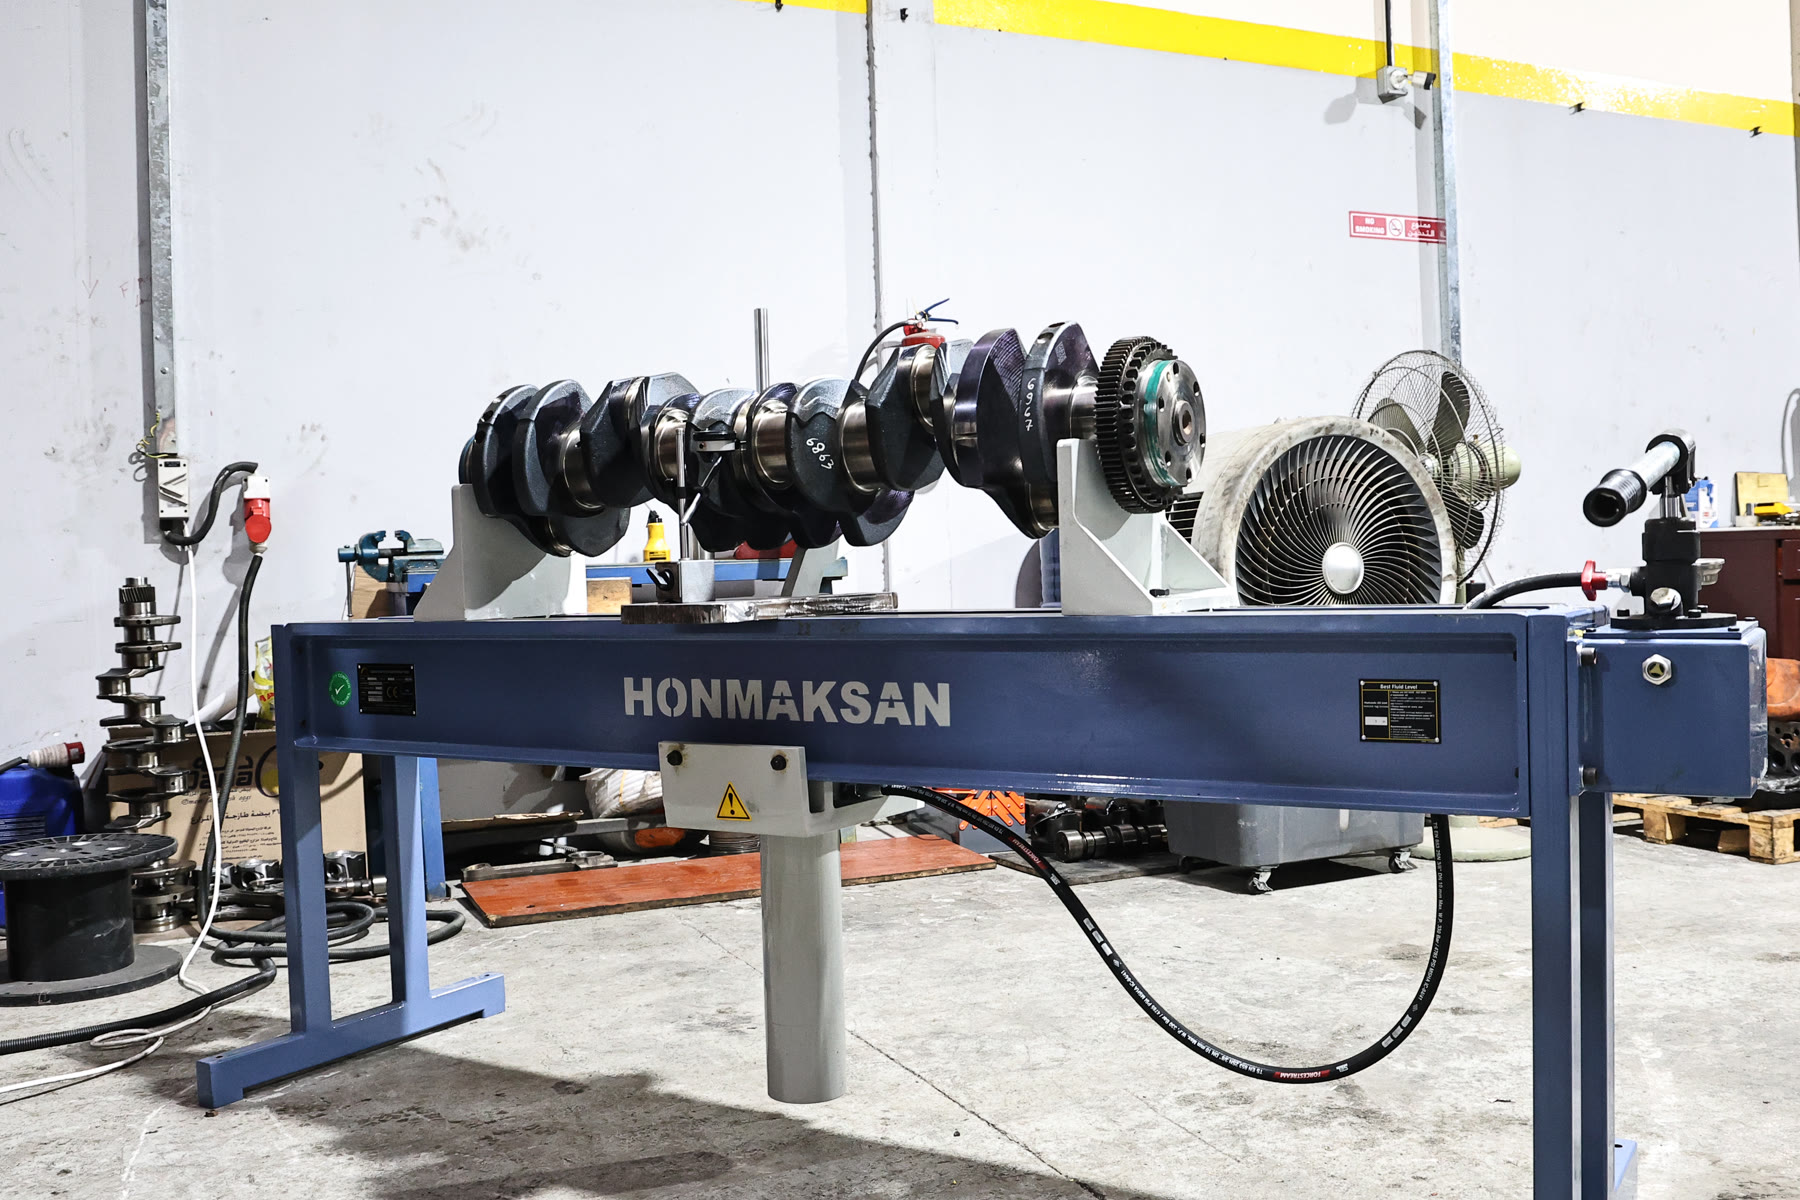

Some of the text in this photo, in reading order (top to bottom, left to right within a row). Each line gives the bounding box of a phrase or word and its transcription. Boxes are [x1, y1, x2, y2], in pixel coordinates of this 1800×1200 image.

[1355, 226, 1385, 234] SMOKING
[1024, 378, 1036, 432] 6967
[806, 438, 834, 470] 6863
[624, 676, 950, 727] HONMAKSAN
